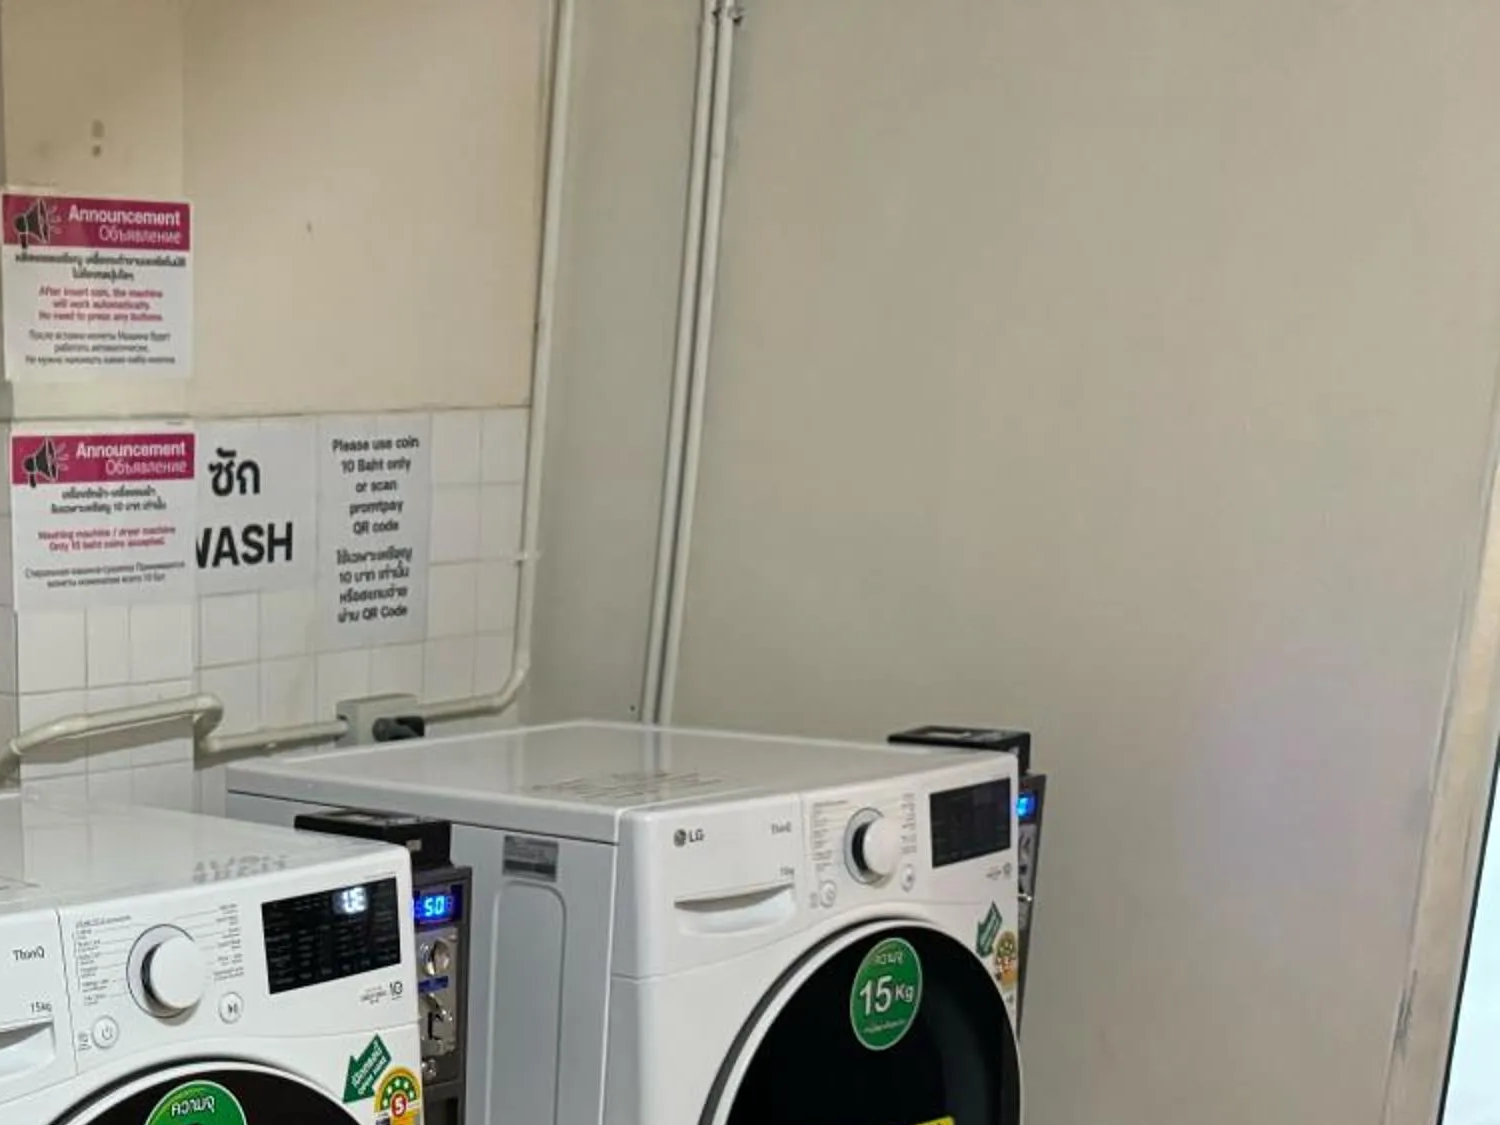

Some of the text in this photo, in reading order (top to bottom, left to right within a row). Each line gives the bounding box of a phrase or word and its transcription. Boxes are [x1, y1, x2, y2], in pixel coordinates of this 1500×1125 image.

[68, 204, 181, 225] Announcement
[99, 224, 182, 245] Объявление
[76, 441, 186, 460] Announcement
[332, 435, 419, 452] Please use coin
[105, 458, 187, 476] Объявление
[208, 447, 260, 496] ซัก
[341, 456, 411, 473] 10 Baht only
[355, 479, 397, 493] or scan
[353, 519, 400, 535] QR code
[339, 570, 352, 584] 10
[688, 828, 705, 843] LG
[425, 895, 445, 917] 50
[860, 975, 915, 1017] 15 Kg
[172, 1095, 215, 1117] ความจุ
